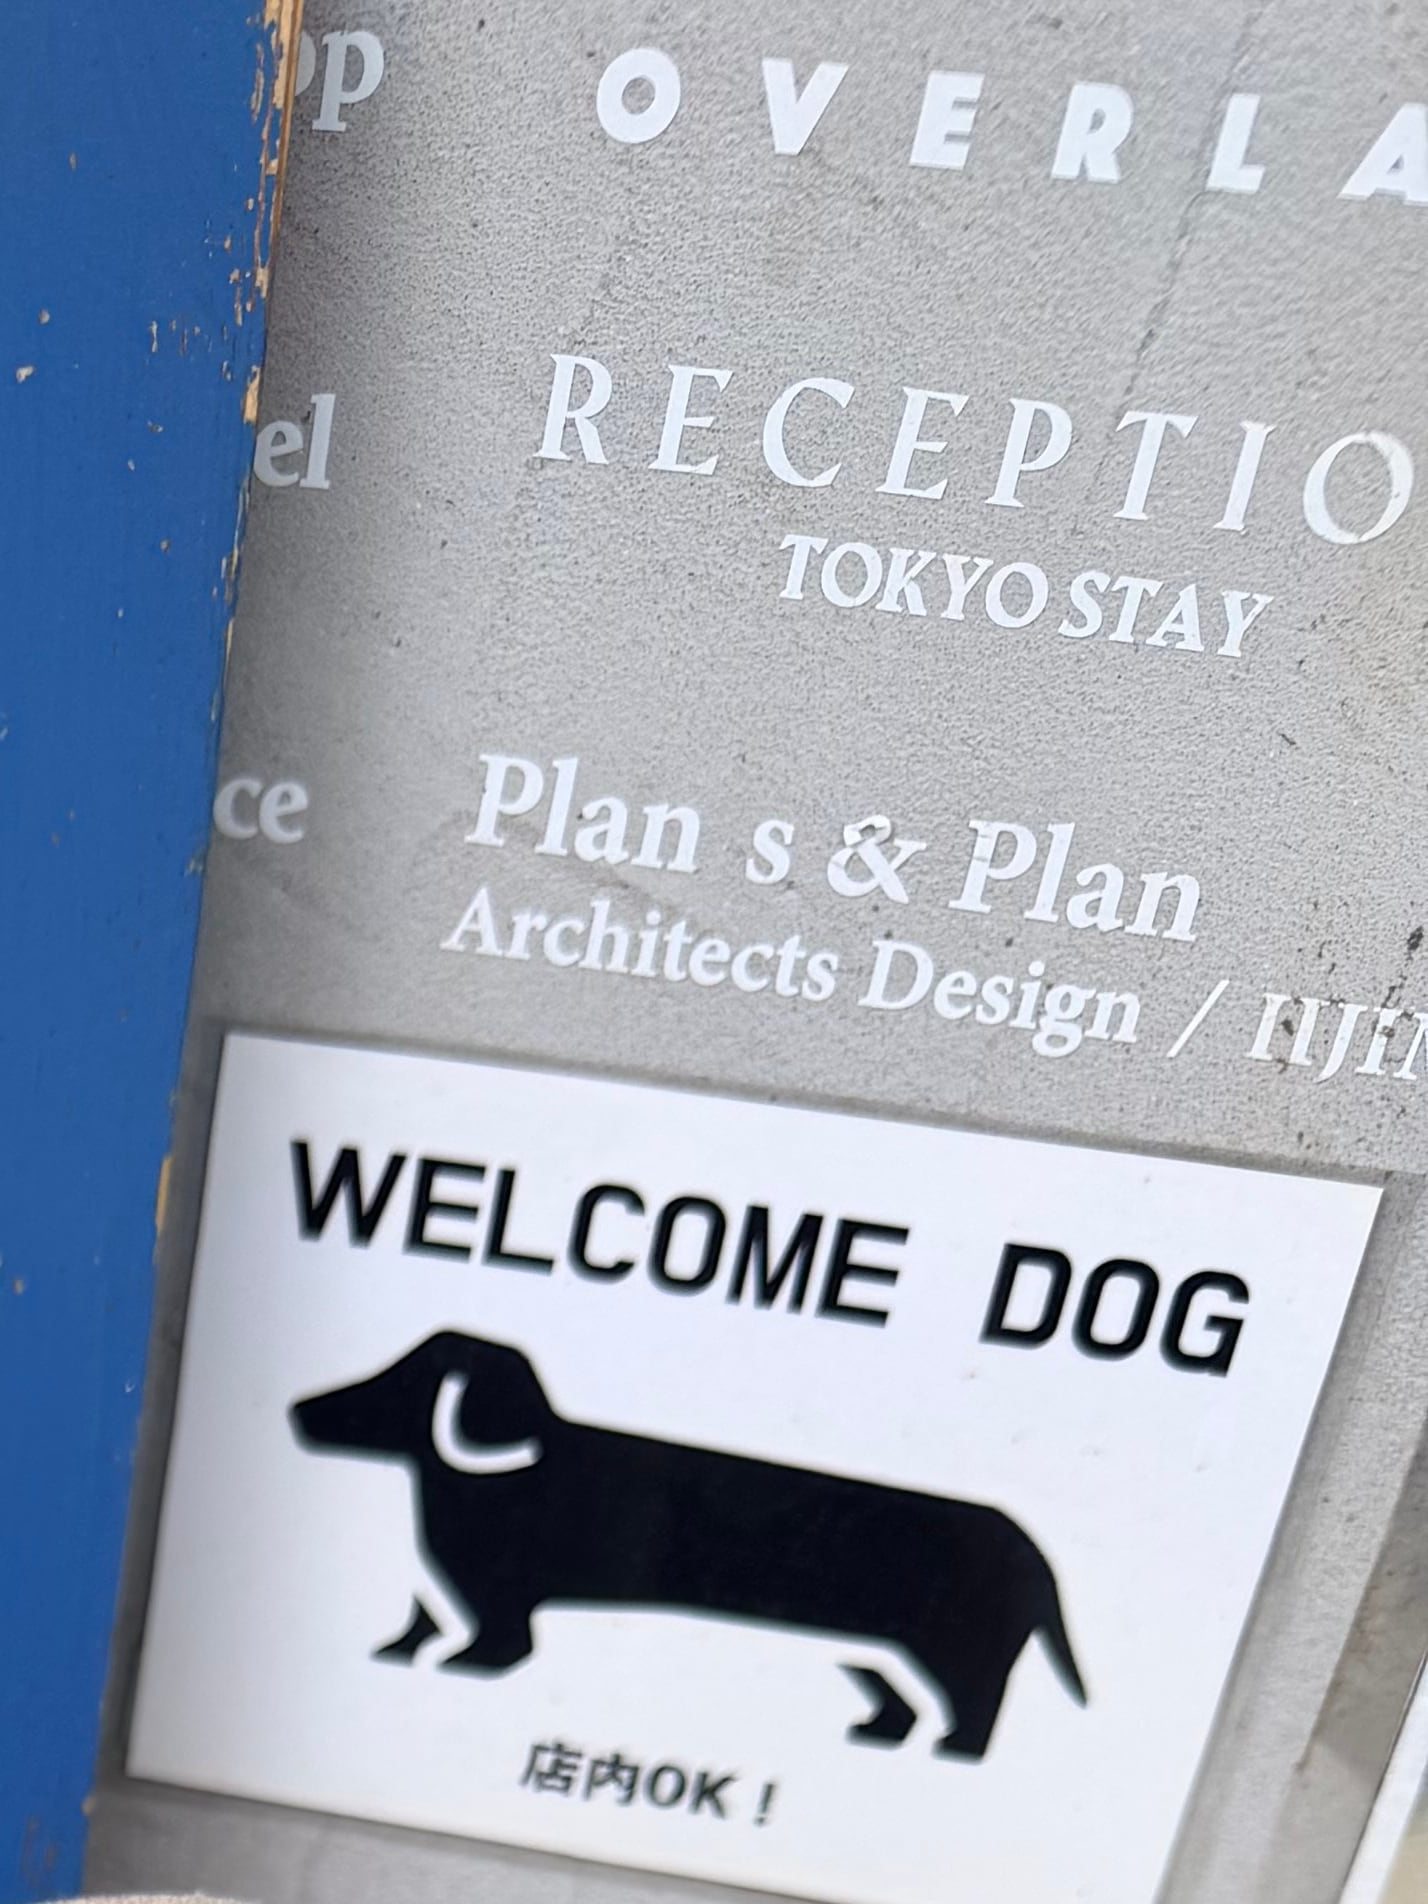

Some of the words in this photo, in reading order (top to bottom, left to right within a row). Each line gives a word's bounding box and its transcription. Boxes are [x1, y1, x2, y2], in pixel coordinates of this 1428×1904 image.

[596, 47, 1428, 205] OVERLA
[532, 353, 1414, 545] RECEPTIO
[778, 533, 1050, 629] TOKYO
[1057, 569, 1275, 658] STAY
[464, 753, 702, 873] Plan
[826, 813, 929, 904] &
[948, 818, 1202, 942] Plan
[440, 886, 839, 1001] Architects
[857, 939, 1142, 1057] Design
[290, 1139, 912, 1326] WELCOME
[980, 1241, 1252, 1378] DOG
